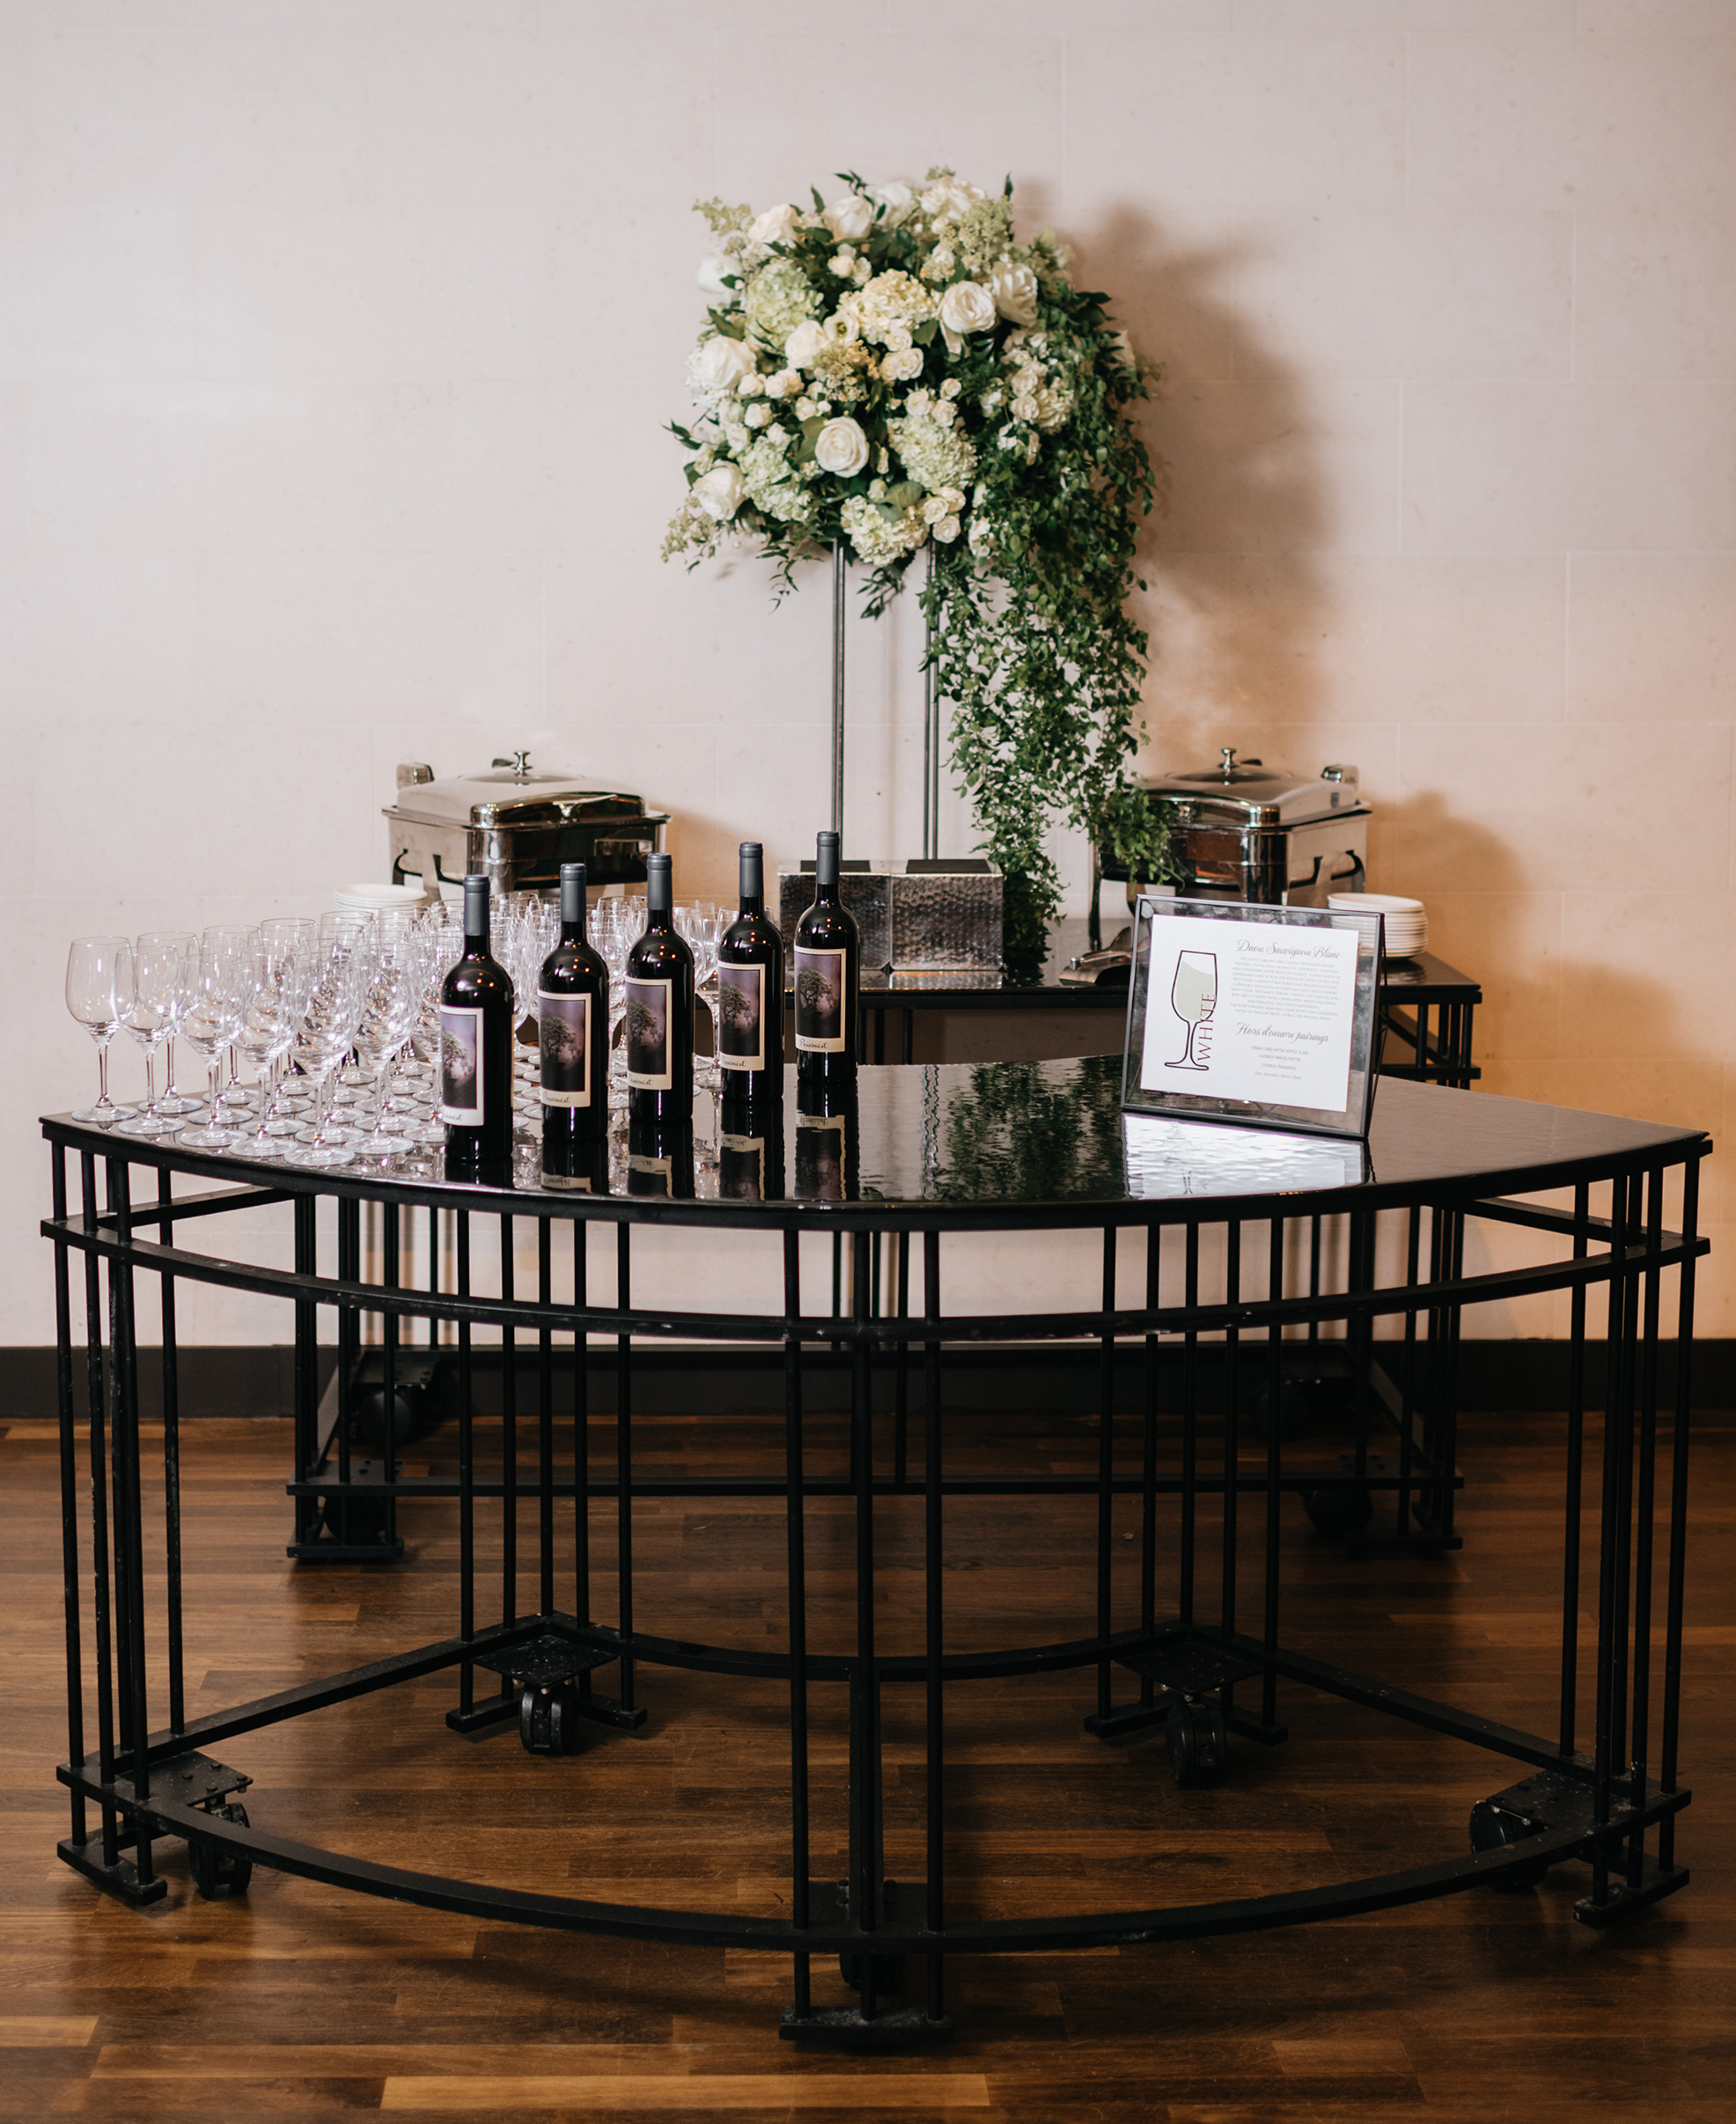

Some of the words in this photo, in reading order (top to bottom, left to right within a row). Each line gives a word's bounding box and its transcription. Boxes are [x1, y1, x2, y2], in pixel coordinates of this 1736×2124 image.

[1235, 938, 1264, 952] Daou
[1266, 941, 1311, 959] Sauvignon
[1312, 945, 1340, 959] Blanc
[1197, 994, 1216, 1061] WHITE
[1235, 1022, 1261, 1036] Hors
[1290, 1031, 1329, 1045] pairings
